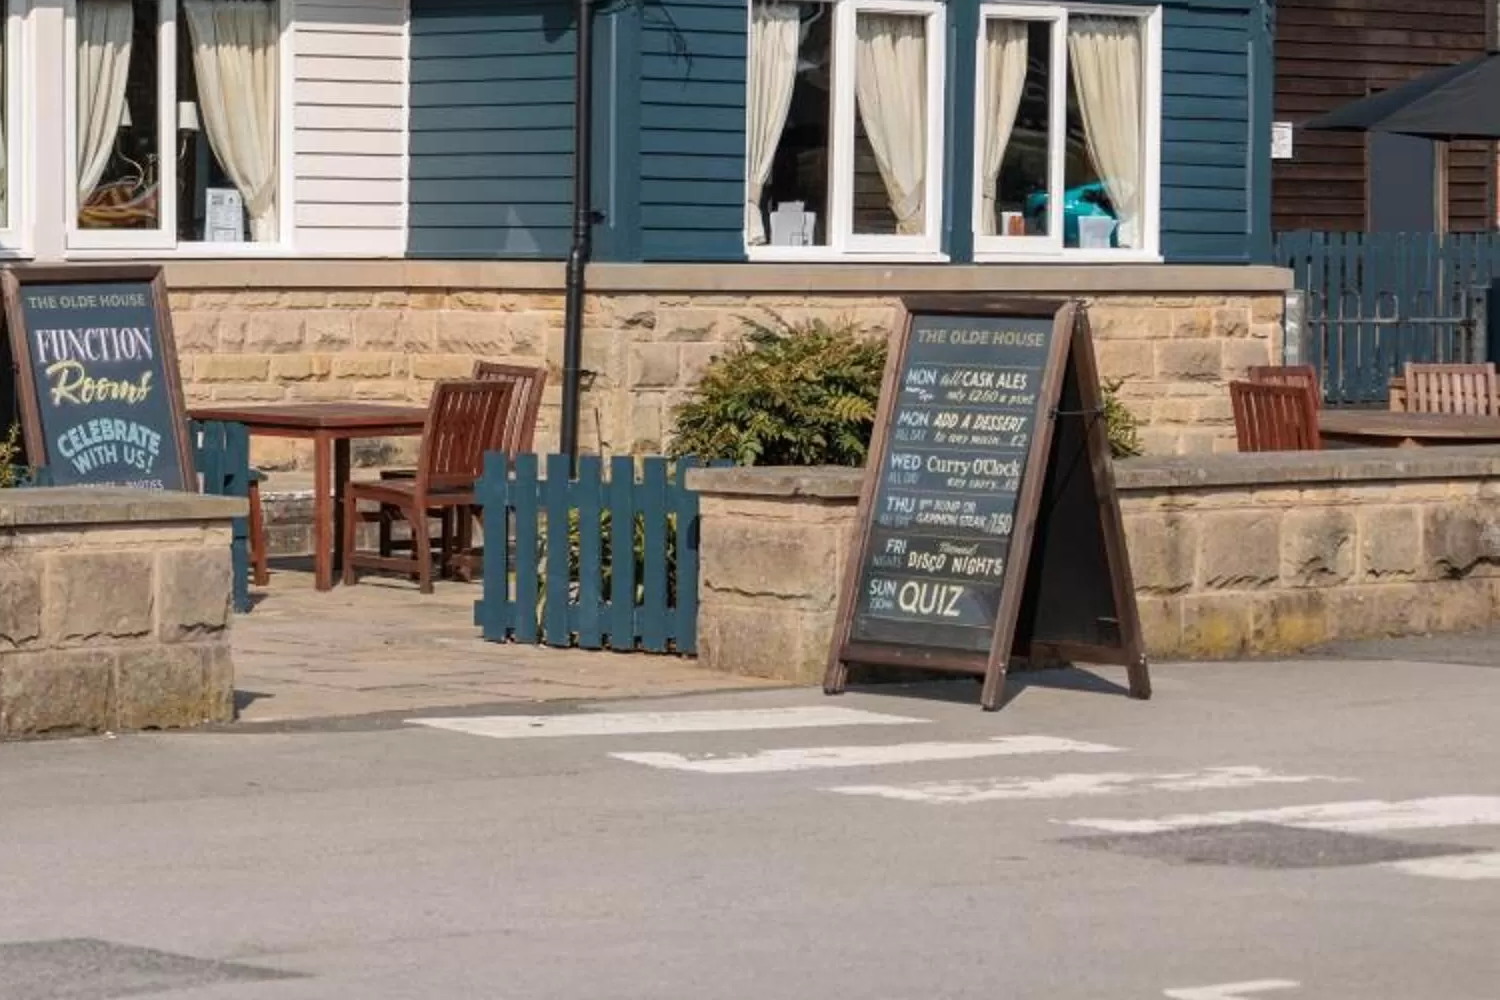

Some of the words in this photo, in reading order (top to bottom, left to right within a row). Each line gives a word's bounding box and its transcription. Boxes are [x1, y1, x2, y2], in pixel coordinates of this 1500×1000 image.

[28, 296, 57, 309] THE
[59, 295, 97, 308] OLDE
[99, 293, 146, 308] HOUSE
[35, 327, 153, 363] FUNCTION
[917, 329, 947, 344] THE
[951, 330, 987, 345] OLDE
[989, 332, 1046, 347] HOUSE
[905, 368, 937, 385] MON
[962, 370, 993, 388] CASK
[996, 372, 1028, 390] ALES
[897, 411, 930, 426] MON
[933, 412, 959, 428] ADD
[960, 414, 972, 429] A
[973, 414, 1028, 432] DESSERT
[56, 417, 162, 458] CELEBRATE
[71, 444, 118, 476] WITH
[123, 446, 154, 475] US!
[891, 453, 921, 470] WED
[927, 455, 970, 476] Curry
[886, 496, 916, 513] THU
[886, 539, 907, 554] FRI
[908, 552, 946, 572] DISCO
[952, 556, 1003, 576] NIGHTS
[869, 579, 897, 596] SUN
[898, 581, 964, 617] QUIZ
